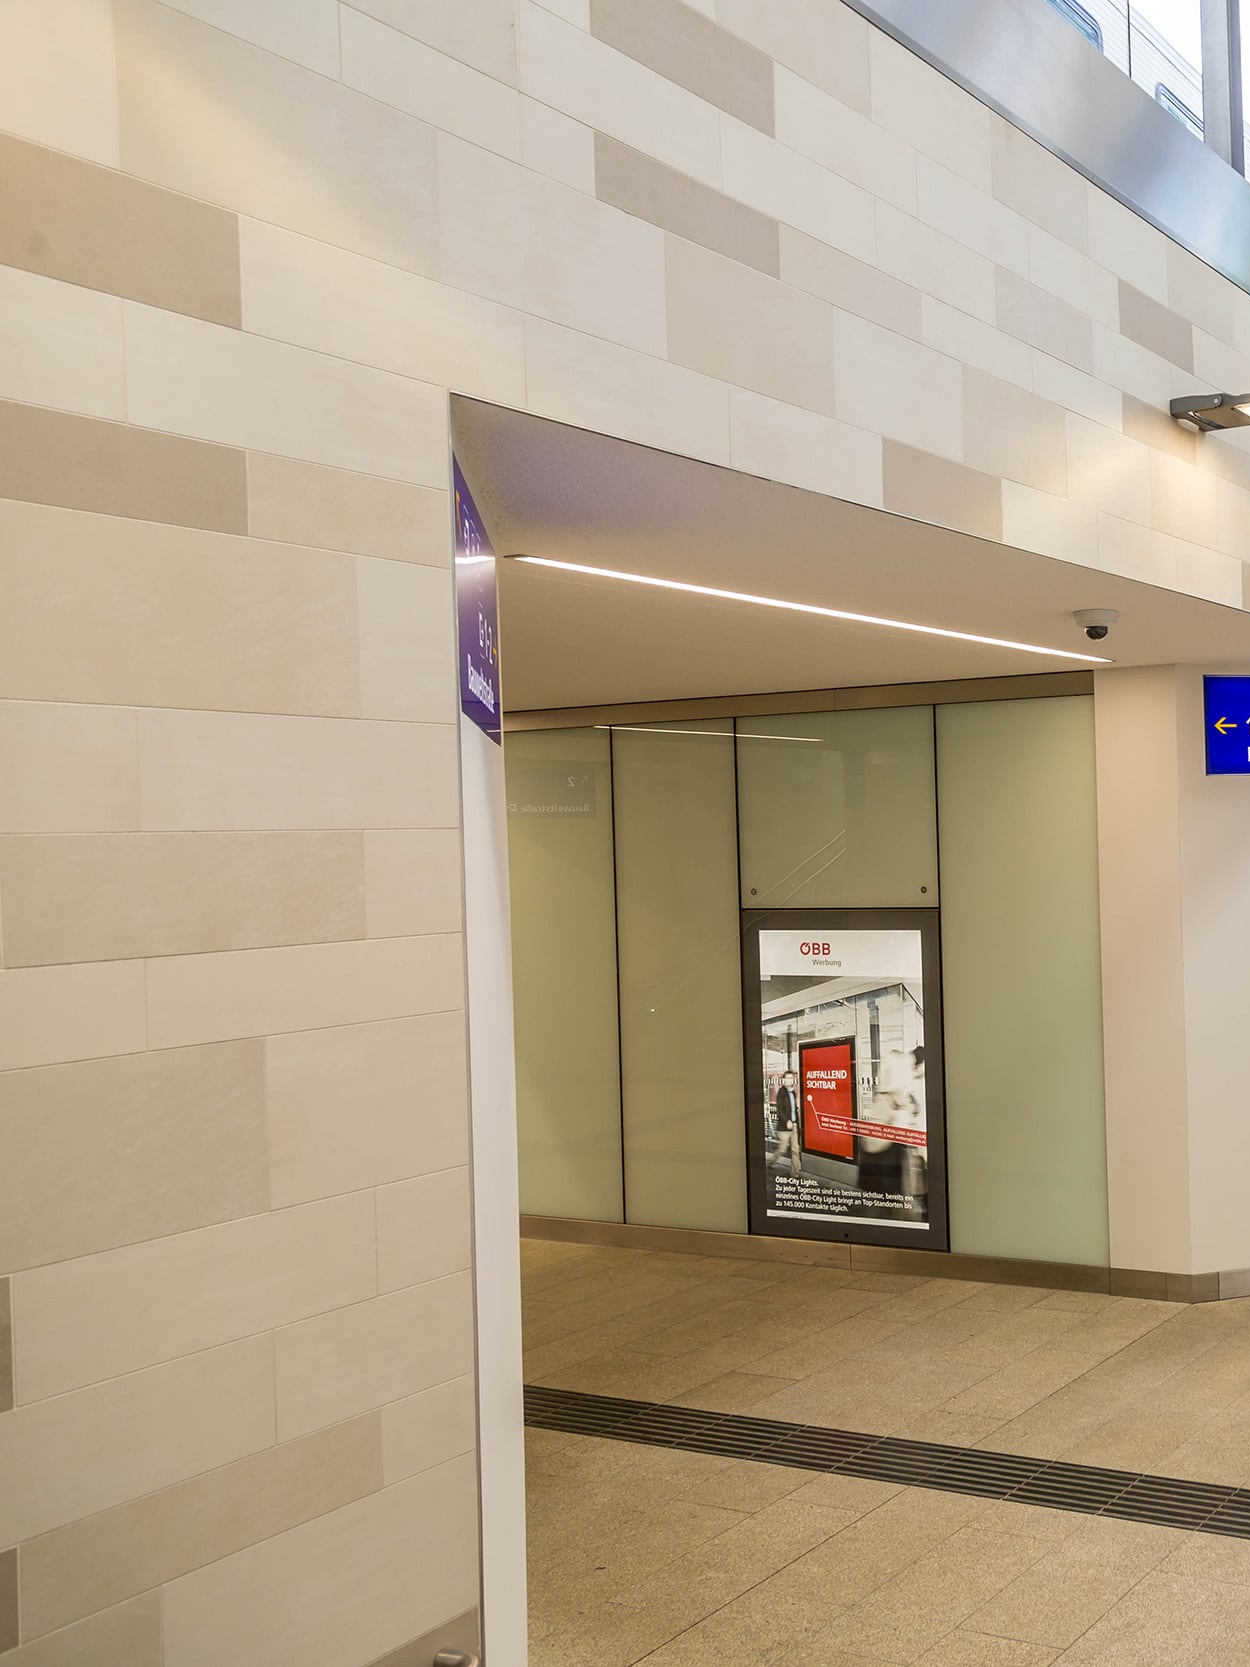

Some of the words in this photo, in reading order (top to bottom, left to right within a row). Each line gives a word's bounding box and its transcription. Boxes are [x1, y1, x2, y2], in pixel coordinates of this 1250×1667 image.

[800, 942, 831, 955] ÖBB
[812, 959, 842, 968] Werbung
[806, 1070, 847, 1079] AUFFALLEND
[806, 1080, 837, 1090] SICHTBAR
[775, 1176, 799, 1186] ÖBB-City
[797, 1186, 820, 1194] Tageszeit
[841, 1189, 861, 1197] bestens
[805, 1202, 828, 1210] Kontakte
[823, 1195, 836, 1204] Light
[837, 1197, 853, 1206] bringt
[904, 1202, 913, 1210] bis
